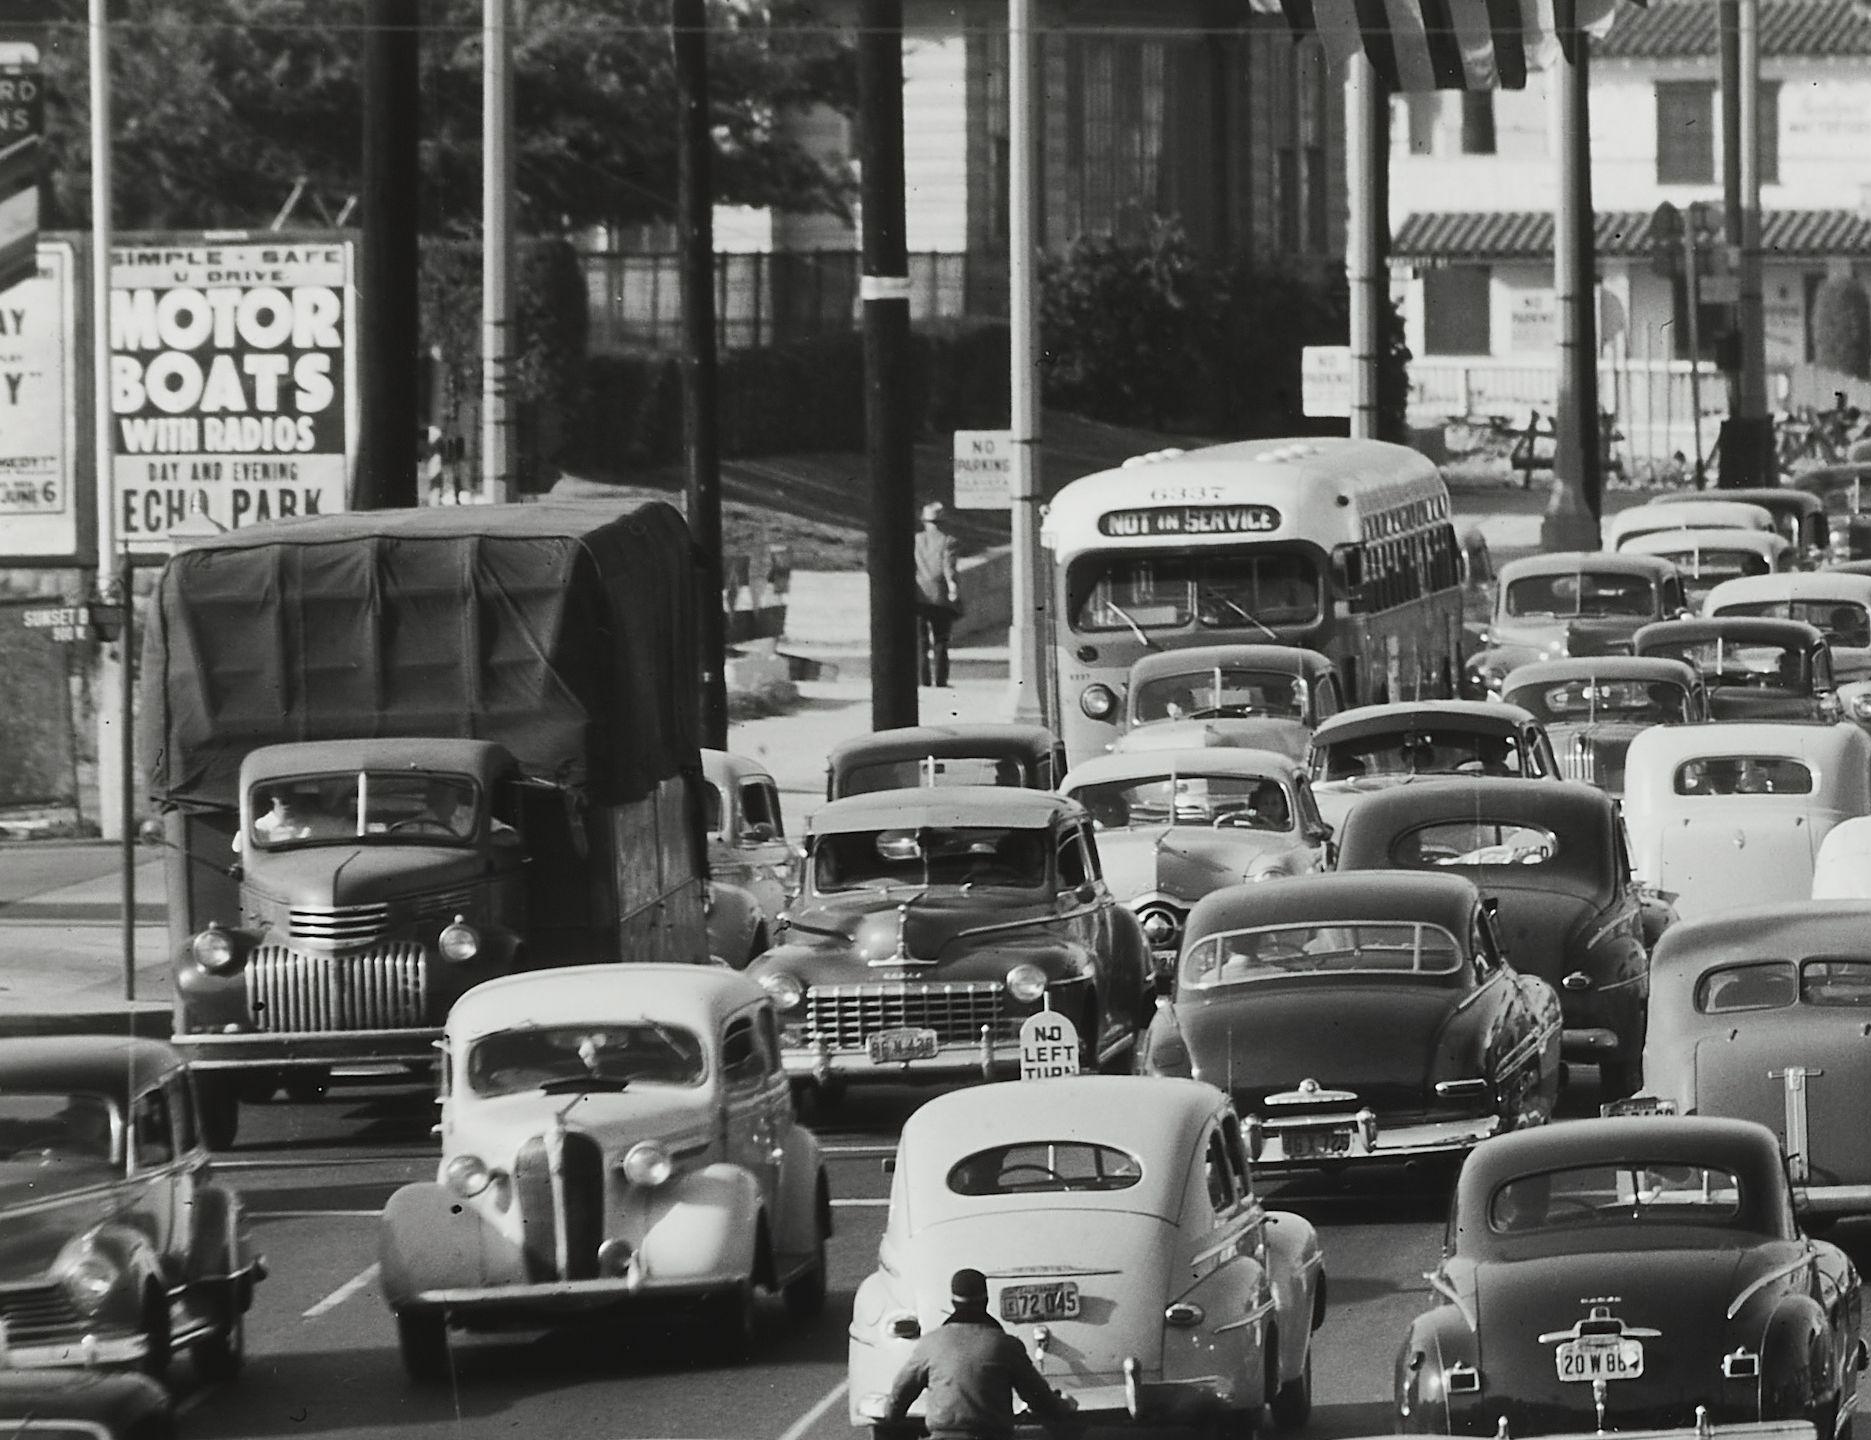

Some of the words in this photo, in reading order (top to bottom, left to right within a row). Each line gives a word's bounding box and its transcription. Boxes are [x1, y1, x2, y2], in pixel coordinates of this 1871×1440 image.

[262, 250, 340, 264] SAFE
[174, 271, 188, 283] U
[207, 271, 283, 283] DRIVE
[110, 286, 343, 351] MOTOR
[111, 351, 335, 413] BOATS
[120, 417, 199, 452] WITH
[204, 415, 315, 452] RADIOS
[972, 440, 995, 455] NO
[149, 463, 180, 482] DAY
[191, 462, 223, 481] AND
[233, 462, 298, 482] EVENING
[956, 459, 1009, 473] PARKING
[43, 481, 56, 502] 6
[232, 488, 322, 530] PARK
[1109, 513, 1150, 536] NOT
[1157, 512, 1180, 531] IN
[1184, 507, 1273, 533] SERVICE
[23, 608, 75, 628] SUNSET
[1034, 1025, 1062, 1042] NO
[1024, 1045, 1075, 1062] LEFT
[1018, 1293, 1040, 1315] 72
[1564, 1354, 1585, 1375] 20
[1590, 1353, 1601, 1374] W
